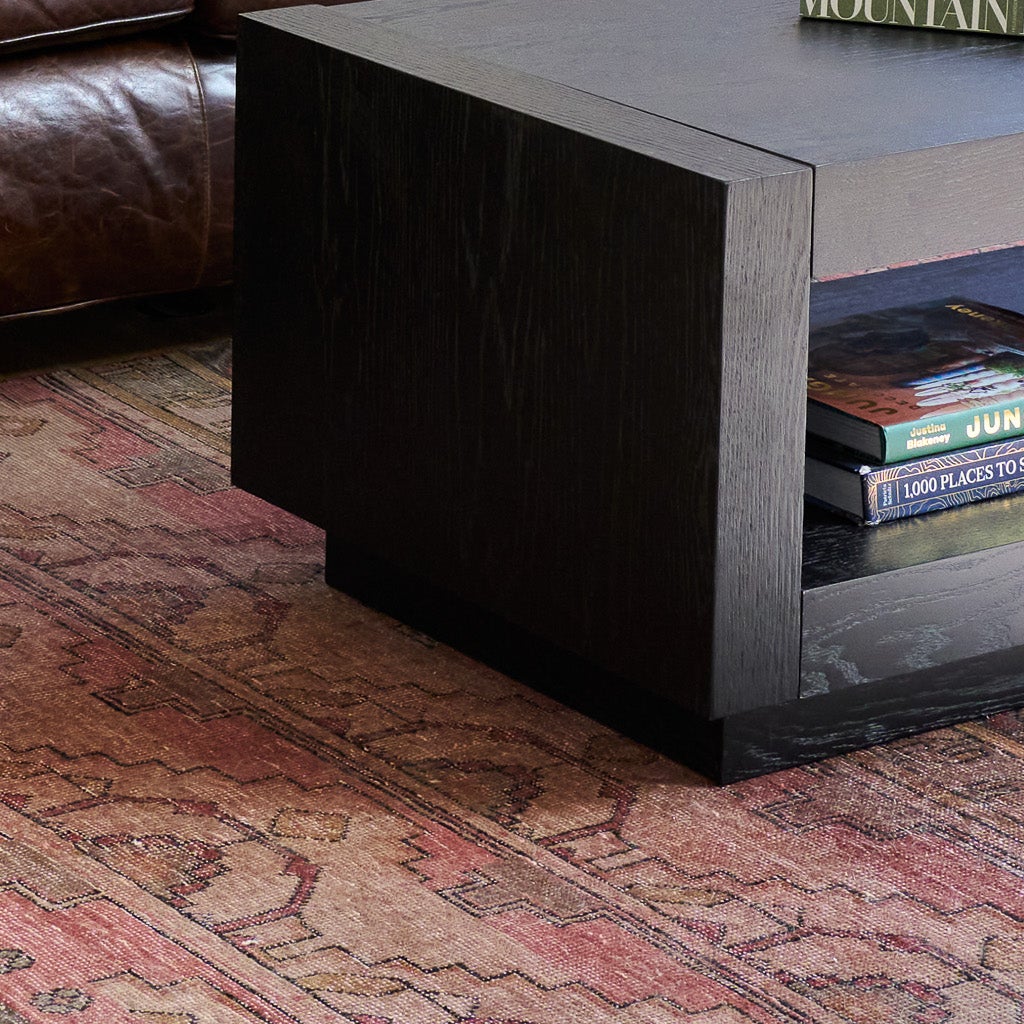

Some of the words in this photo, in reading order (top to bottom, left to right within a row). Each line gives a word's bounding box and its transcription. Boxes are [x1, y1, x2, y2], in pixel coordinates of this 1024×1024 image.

[910, 424, 946, 437] Justina
[906, 433, 951, 450] Blakeney
[903, 477, 938, 499] 1,000
[940, 464, 994, 491] PLACES
[995, 459, 1017, 478] TO
